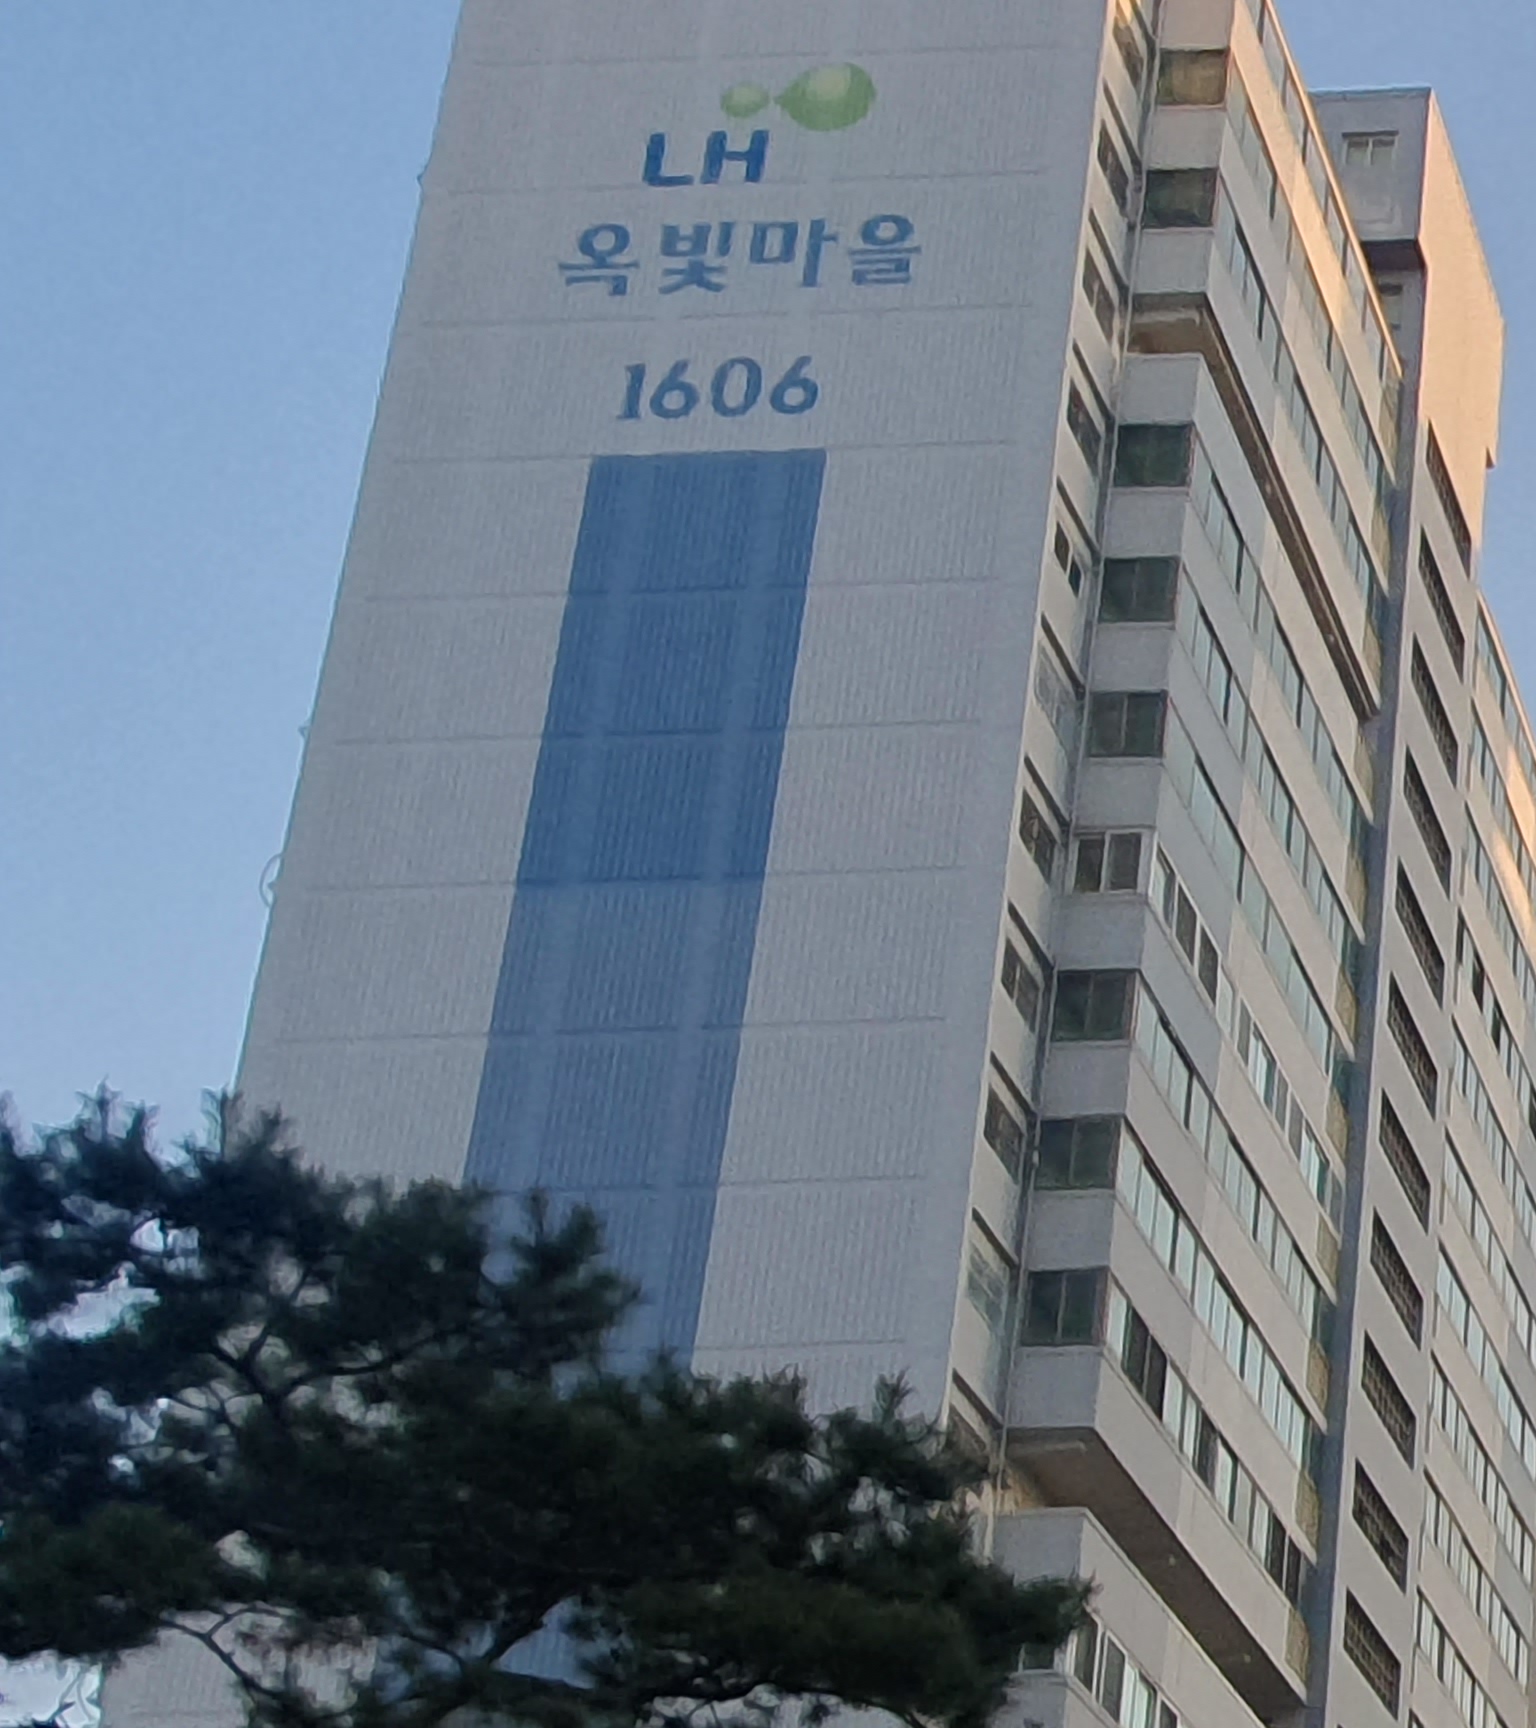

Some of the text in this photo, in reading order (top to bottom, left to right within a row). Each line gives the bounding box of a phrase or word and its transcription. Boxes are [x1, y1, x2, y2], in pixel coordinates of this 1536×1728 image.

[642, 130, 769, 187] LH
[558, 214, 921, 296] 옥빛마을
[616, 356, 820, 420] 1606
